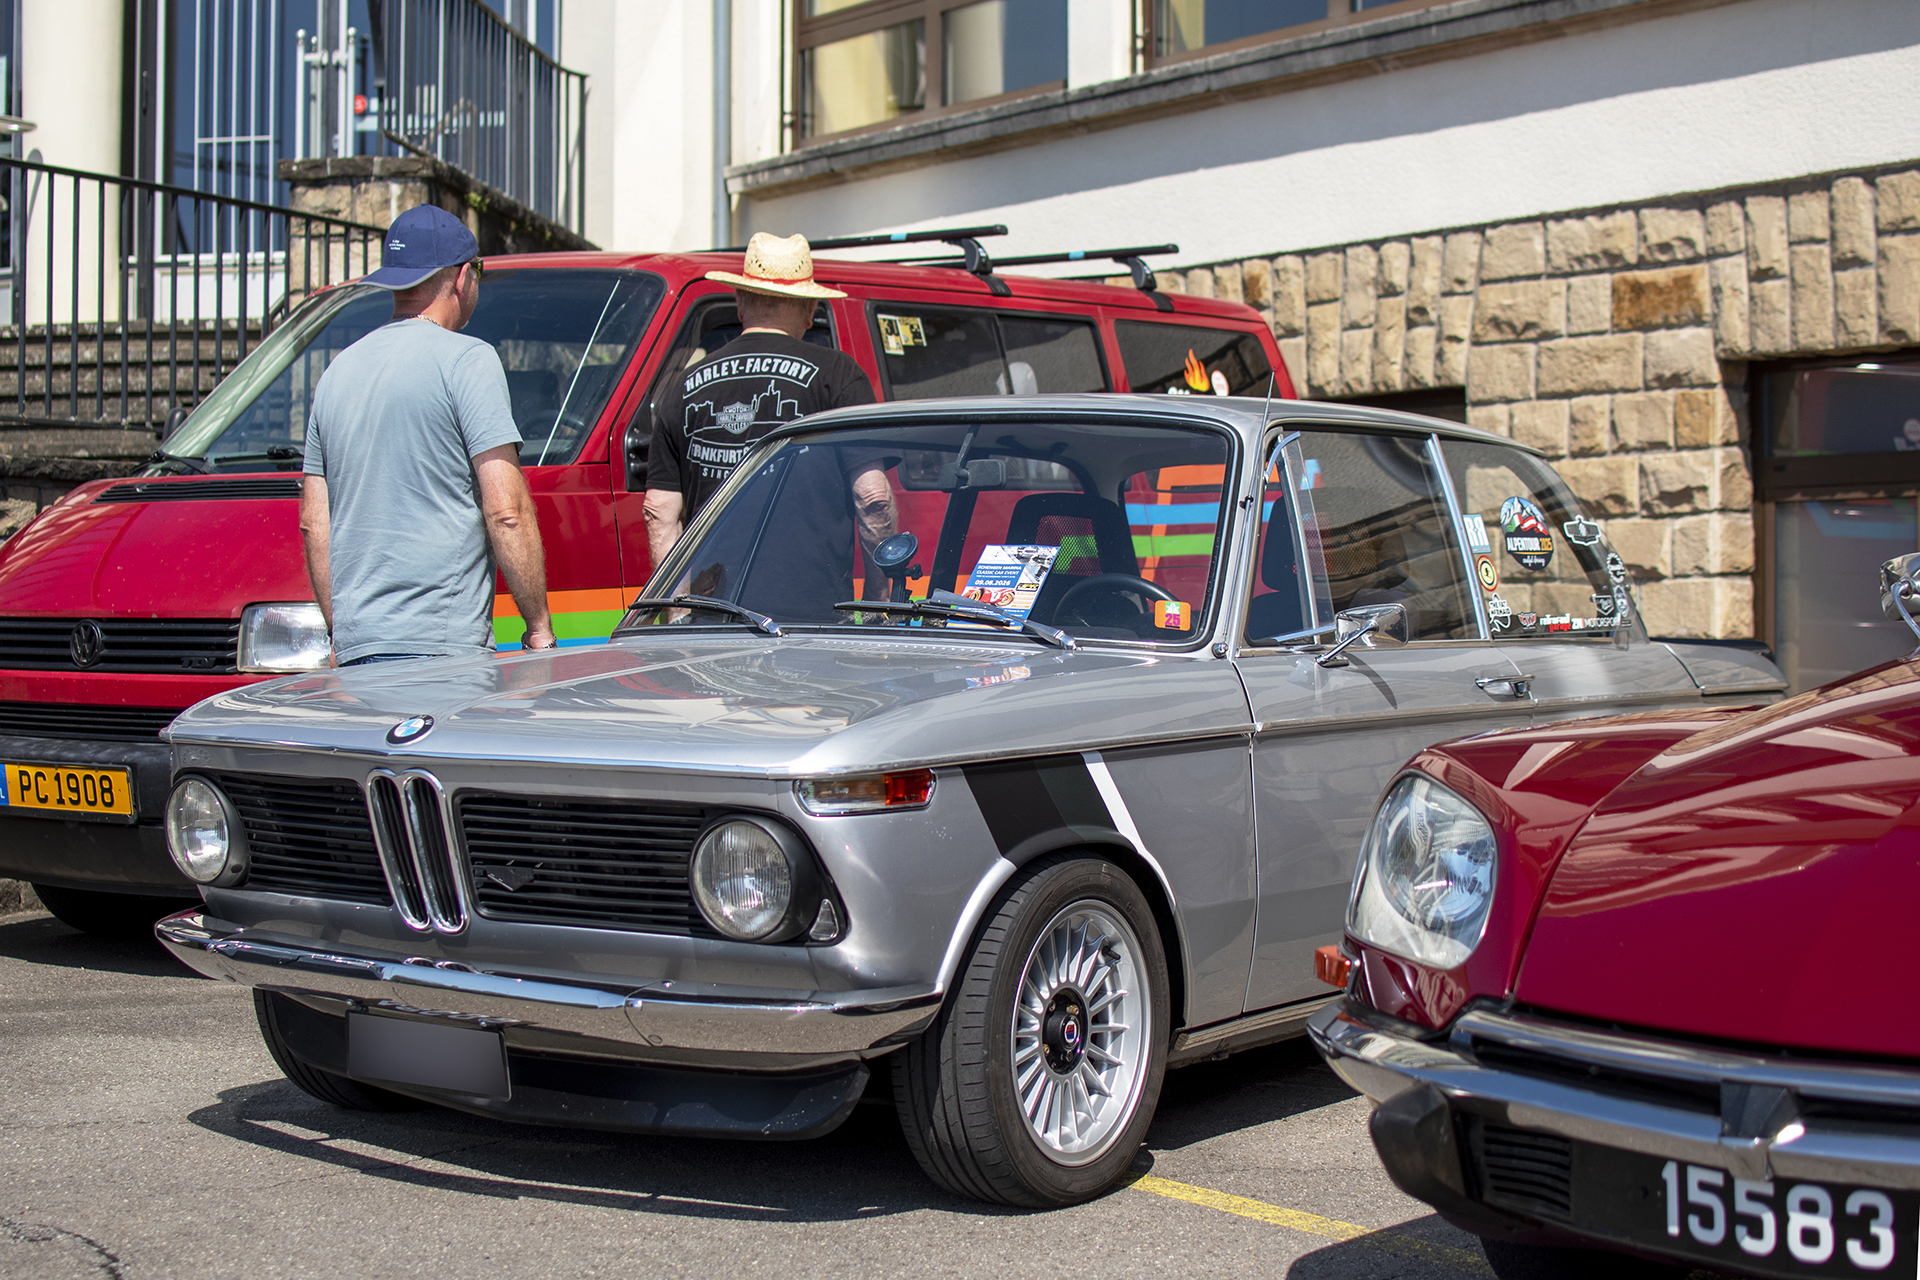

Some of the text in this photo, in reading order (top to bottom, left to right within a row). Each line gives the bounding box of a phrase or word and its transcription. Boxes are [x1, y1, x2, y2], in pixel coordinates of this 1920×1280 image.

[702, 467, 730, 480] SINC
[1506, 537, 1541, 551] ALPENTOUR
[1164, 613, 1181, 626] 25
[1661, 1159, 1896, 1271] 15583
